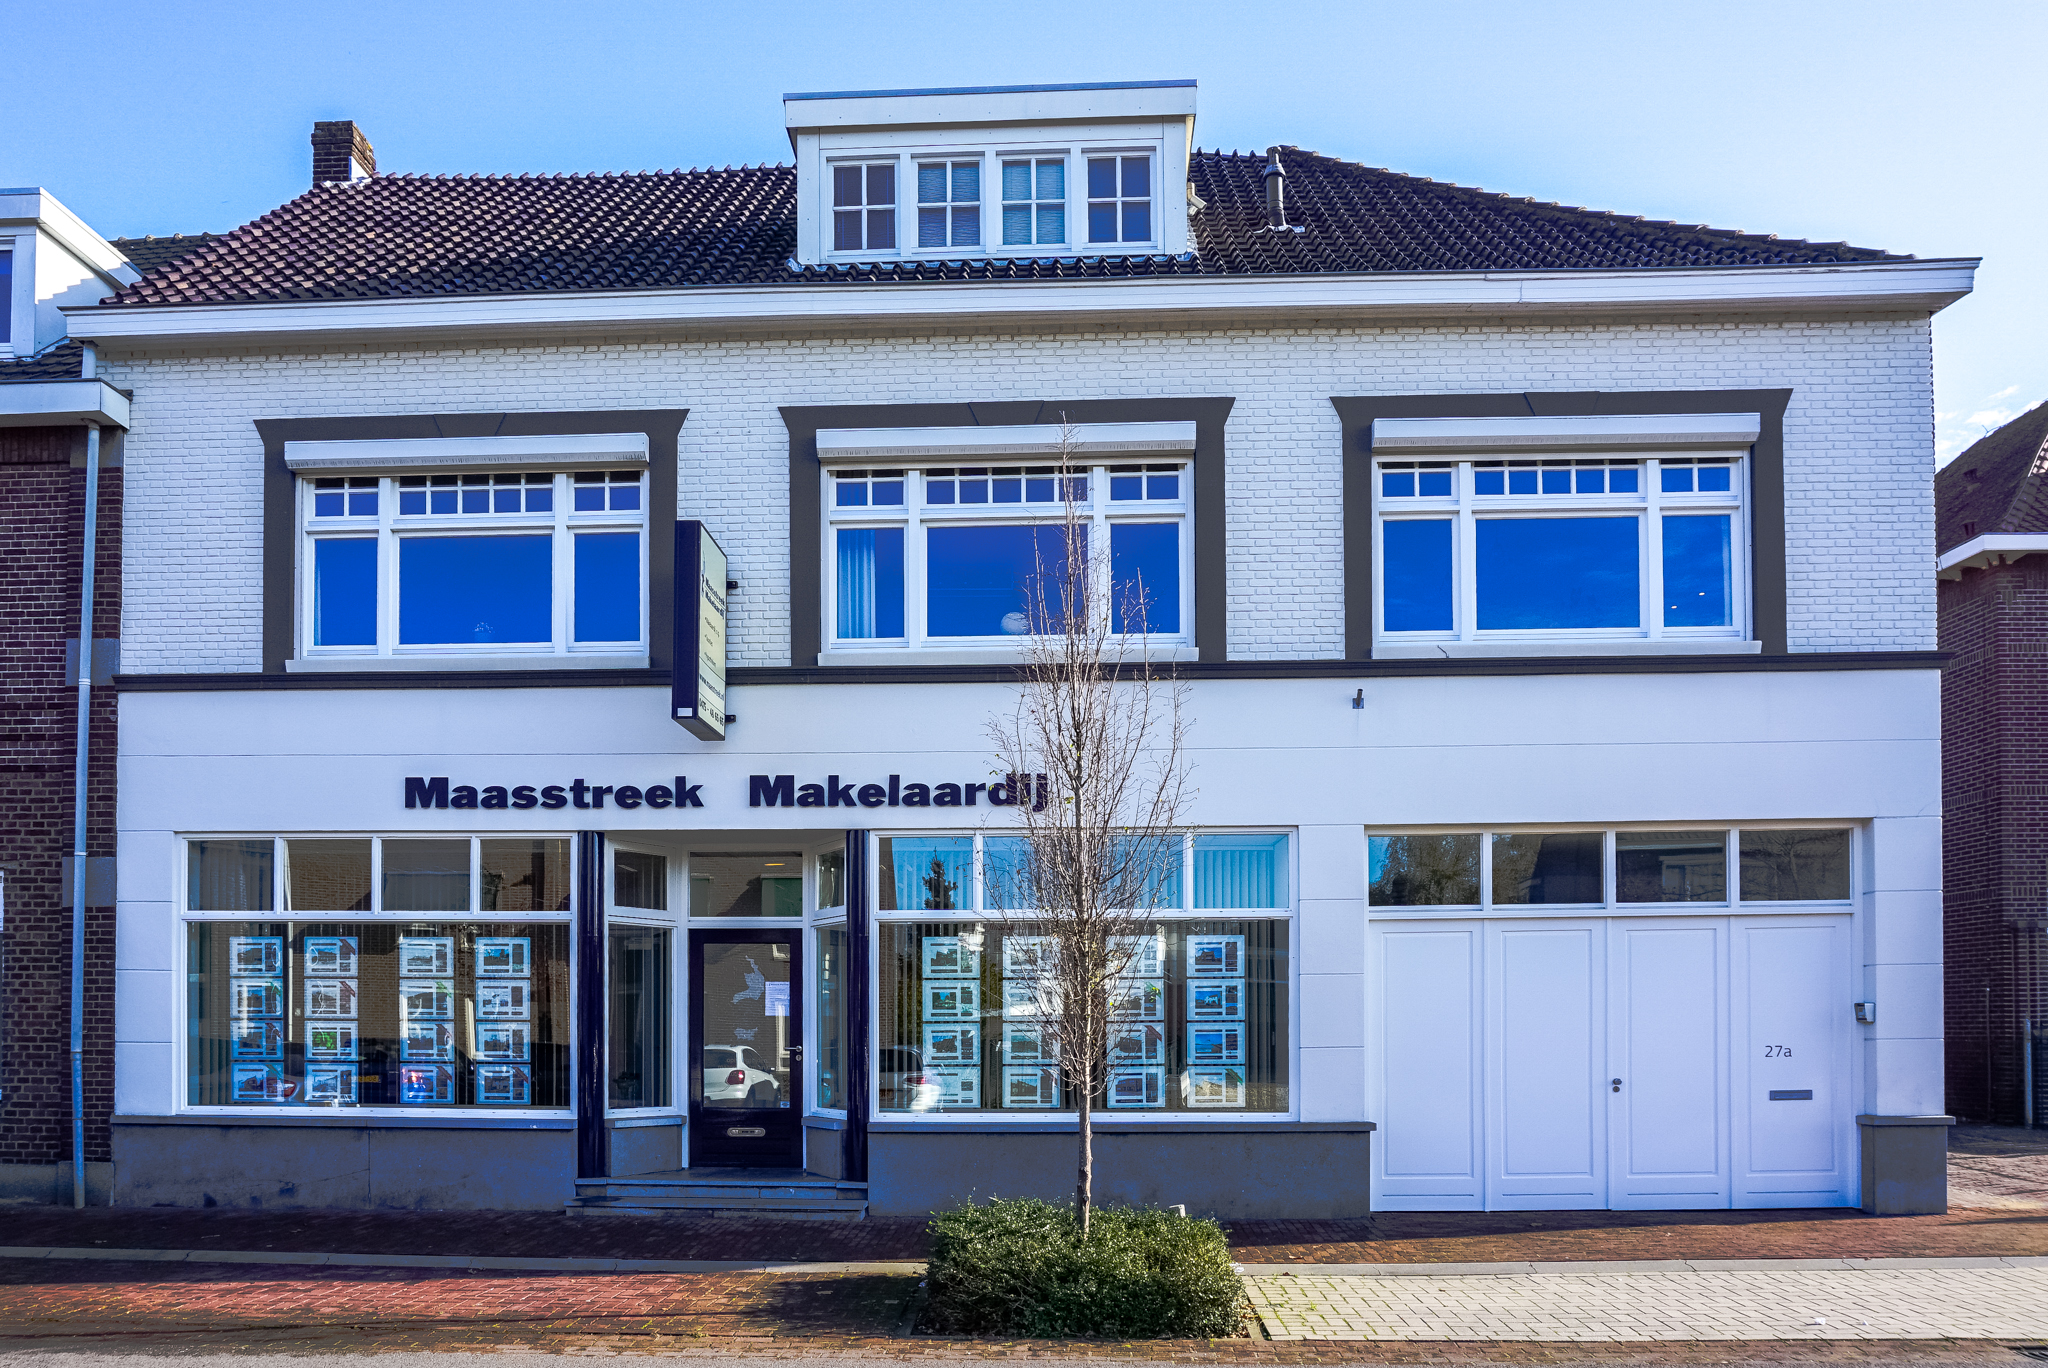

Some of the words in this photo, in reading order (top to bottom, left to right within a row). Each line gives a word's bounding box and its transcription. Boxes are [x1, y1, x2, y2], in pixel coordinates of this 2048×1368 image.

[404, 776, 704, 809] Maasstreek
[749, 773, 1048, 813] Makelaardij
[1764, 1045, 1792, 1058] 27a
